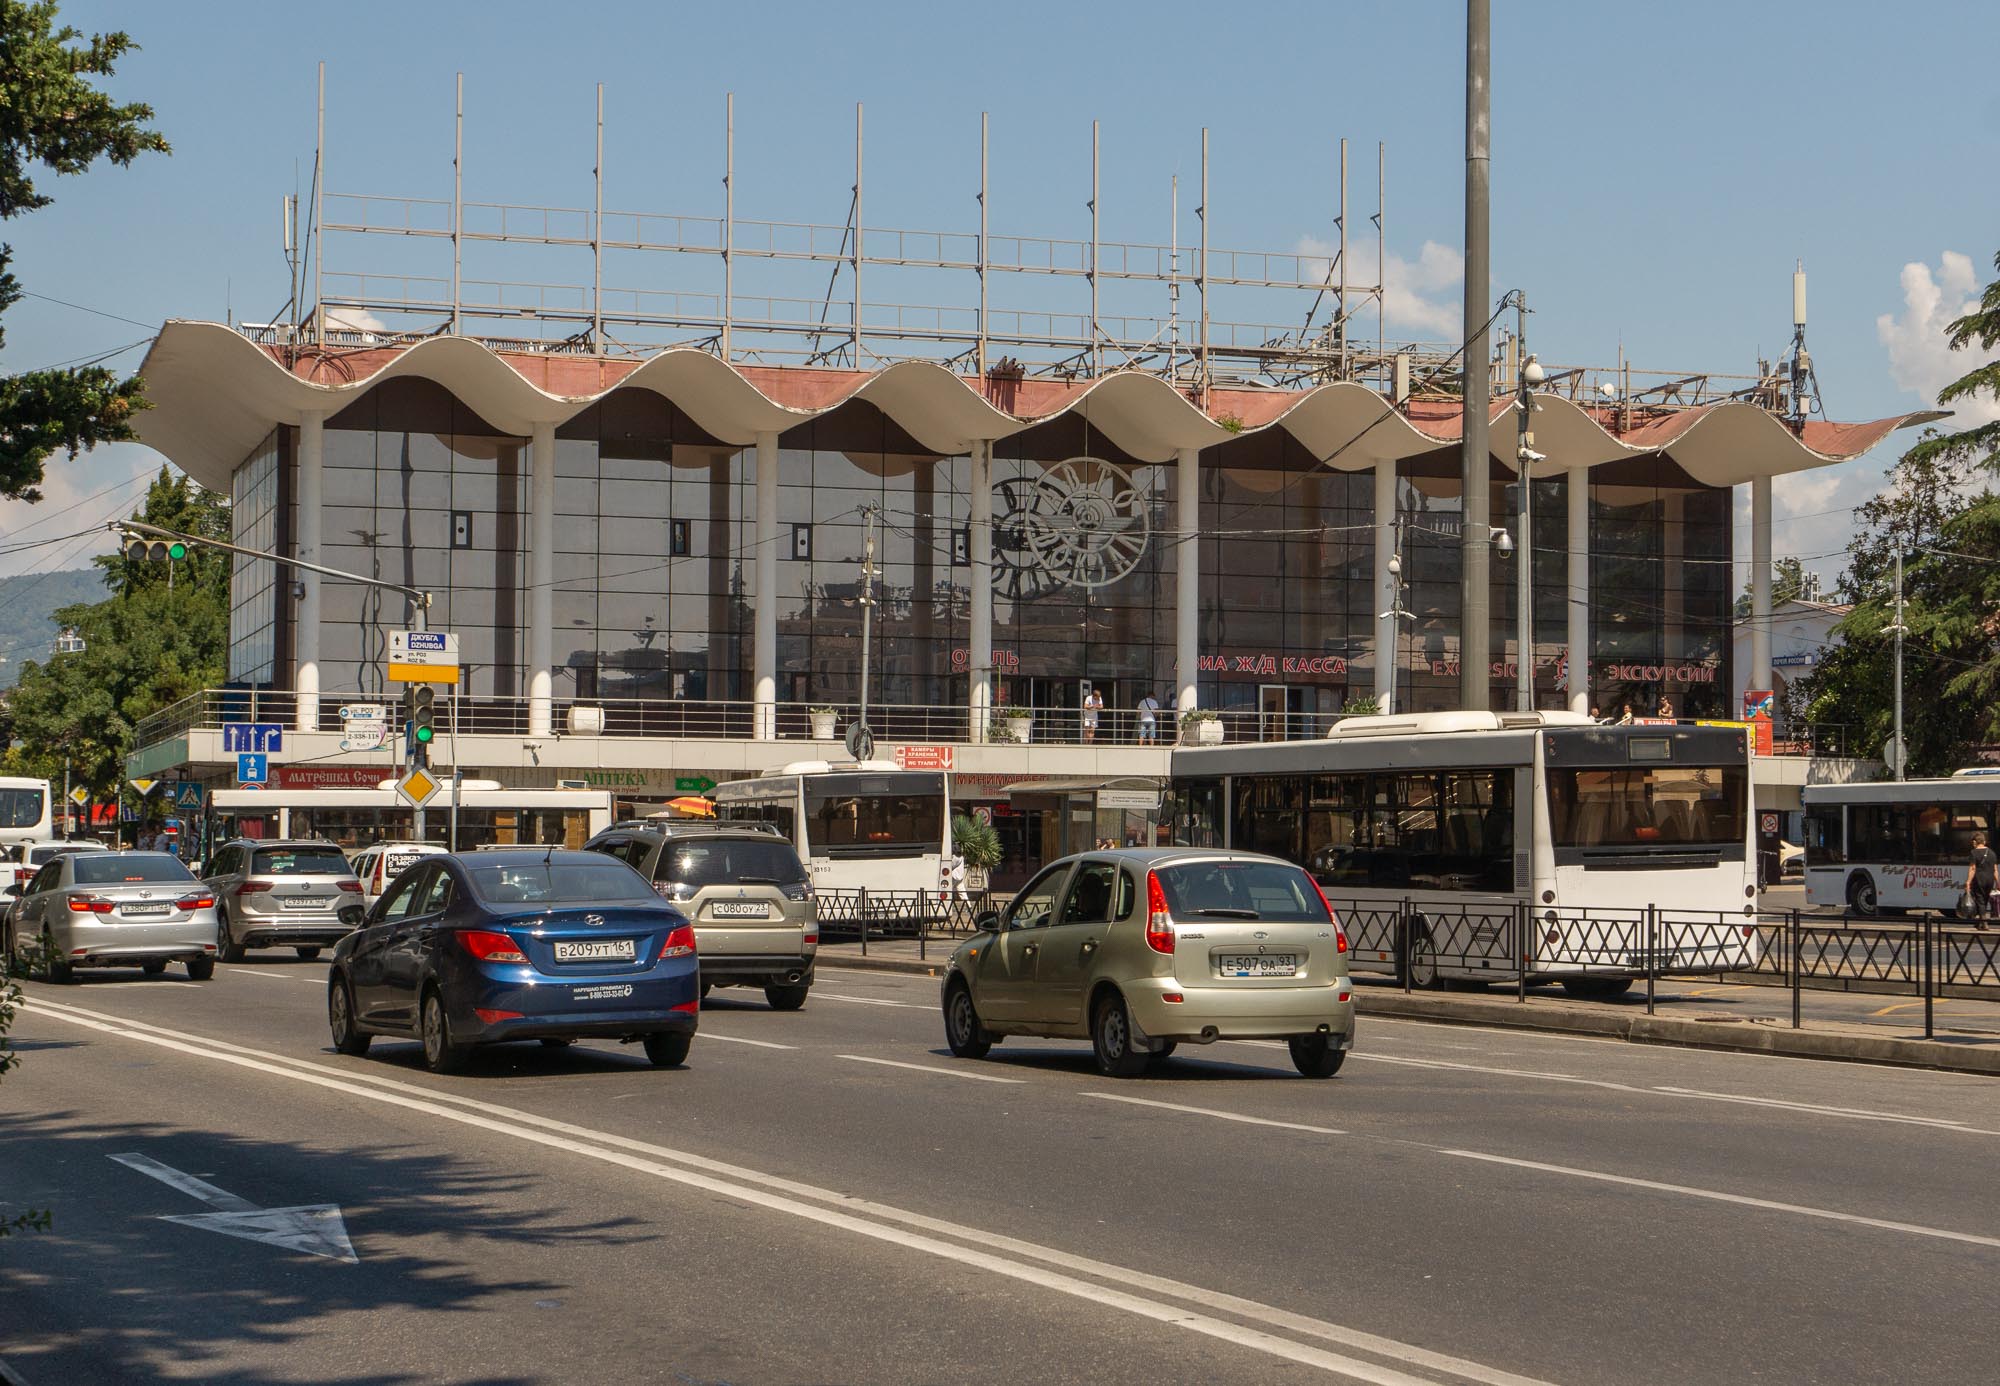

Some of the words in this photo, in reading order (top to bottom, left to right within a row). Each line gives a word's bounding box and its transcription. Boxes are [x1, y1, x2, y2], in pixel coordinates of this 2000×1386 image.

[411, 634, 439, 642] ДЖУБГА
[411, 642, 443, 650] DZHUBGA
[952, 649, 1019, 666] ОЛЬ
[1236, 654, 1277, 674] Ж/Д
[1283, 657, 1347, 674] КАССА
[1608, 664, 1715, 682] ЭКСКУРСИИ
[288, 771, 350, 782] МАТРЁШКА
[584, 771, 647, 786] АПТЕКА
[1916, 867, 1952, 880] ПОБЕДА!
